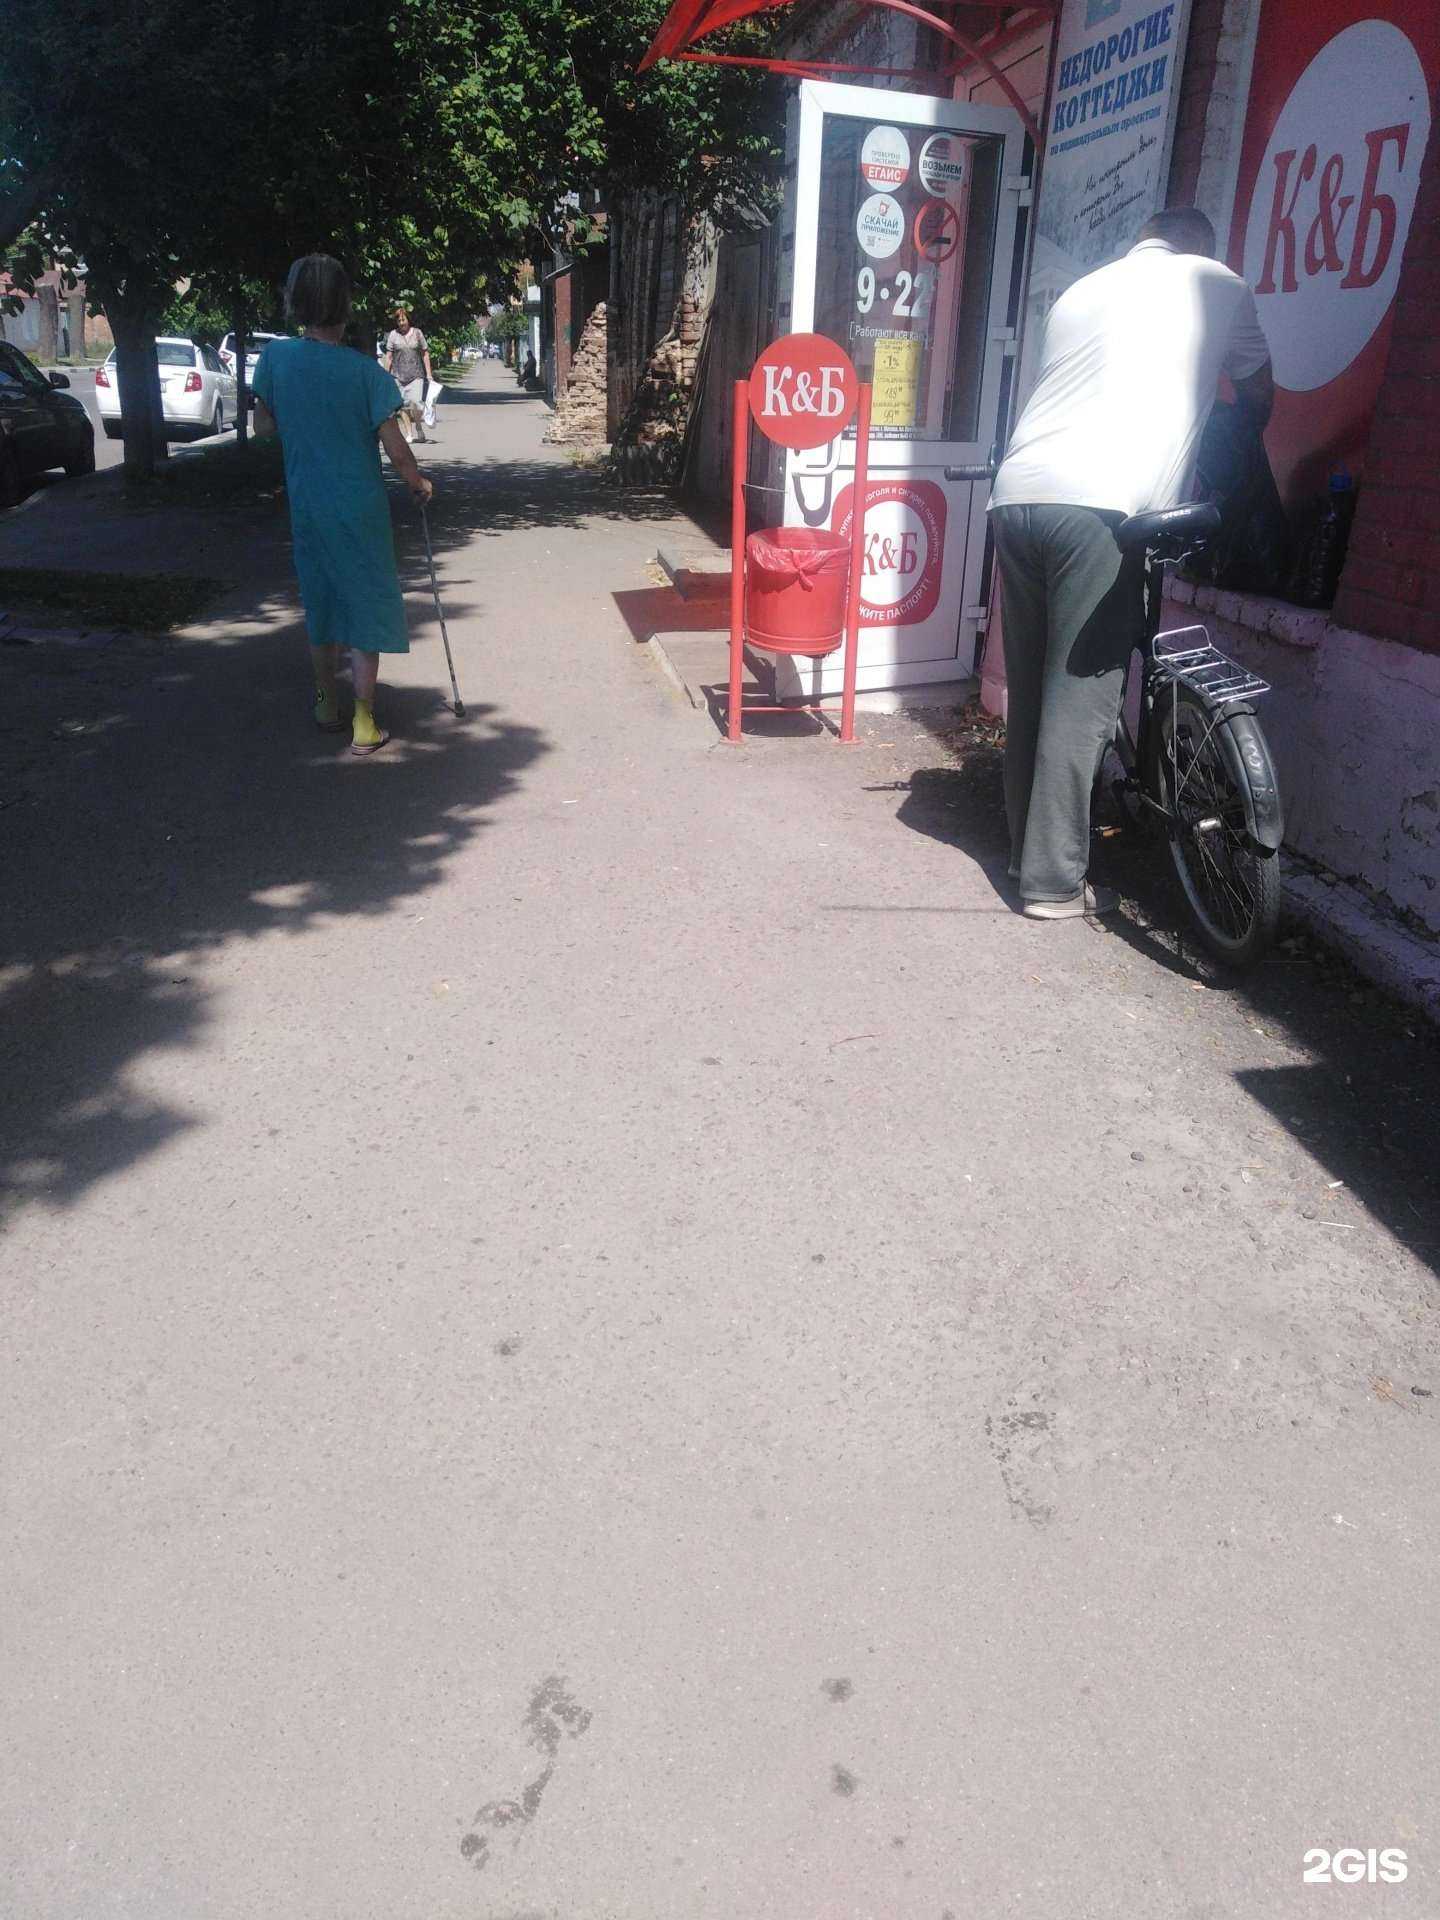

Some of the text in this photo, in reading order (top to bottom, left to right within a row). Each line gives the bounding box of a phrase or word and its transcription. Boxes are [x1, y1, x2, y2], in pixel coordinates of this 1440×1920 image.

[1058, 3, 1175, 92] НЕДОРОГИЕ
[1052, 54, 1168, 134] КОТТЕДЖИ
[868, 166, 902, 181] ЕГАИС
[922, 160, 962, 175] ВОЗЬМЕМ
[864, 214, 899, 229] СКАЧАЙ
[1255, 123, 1410, 294] К&Б
[761, 366, 845, 416] К&Б
